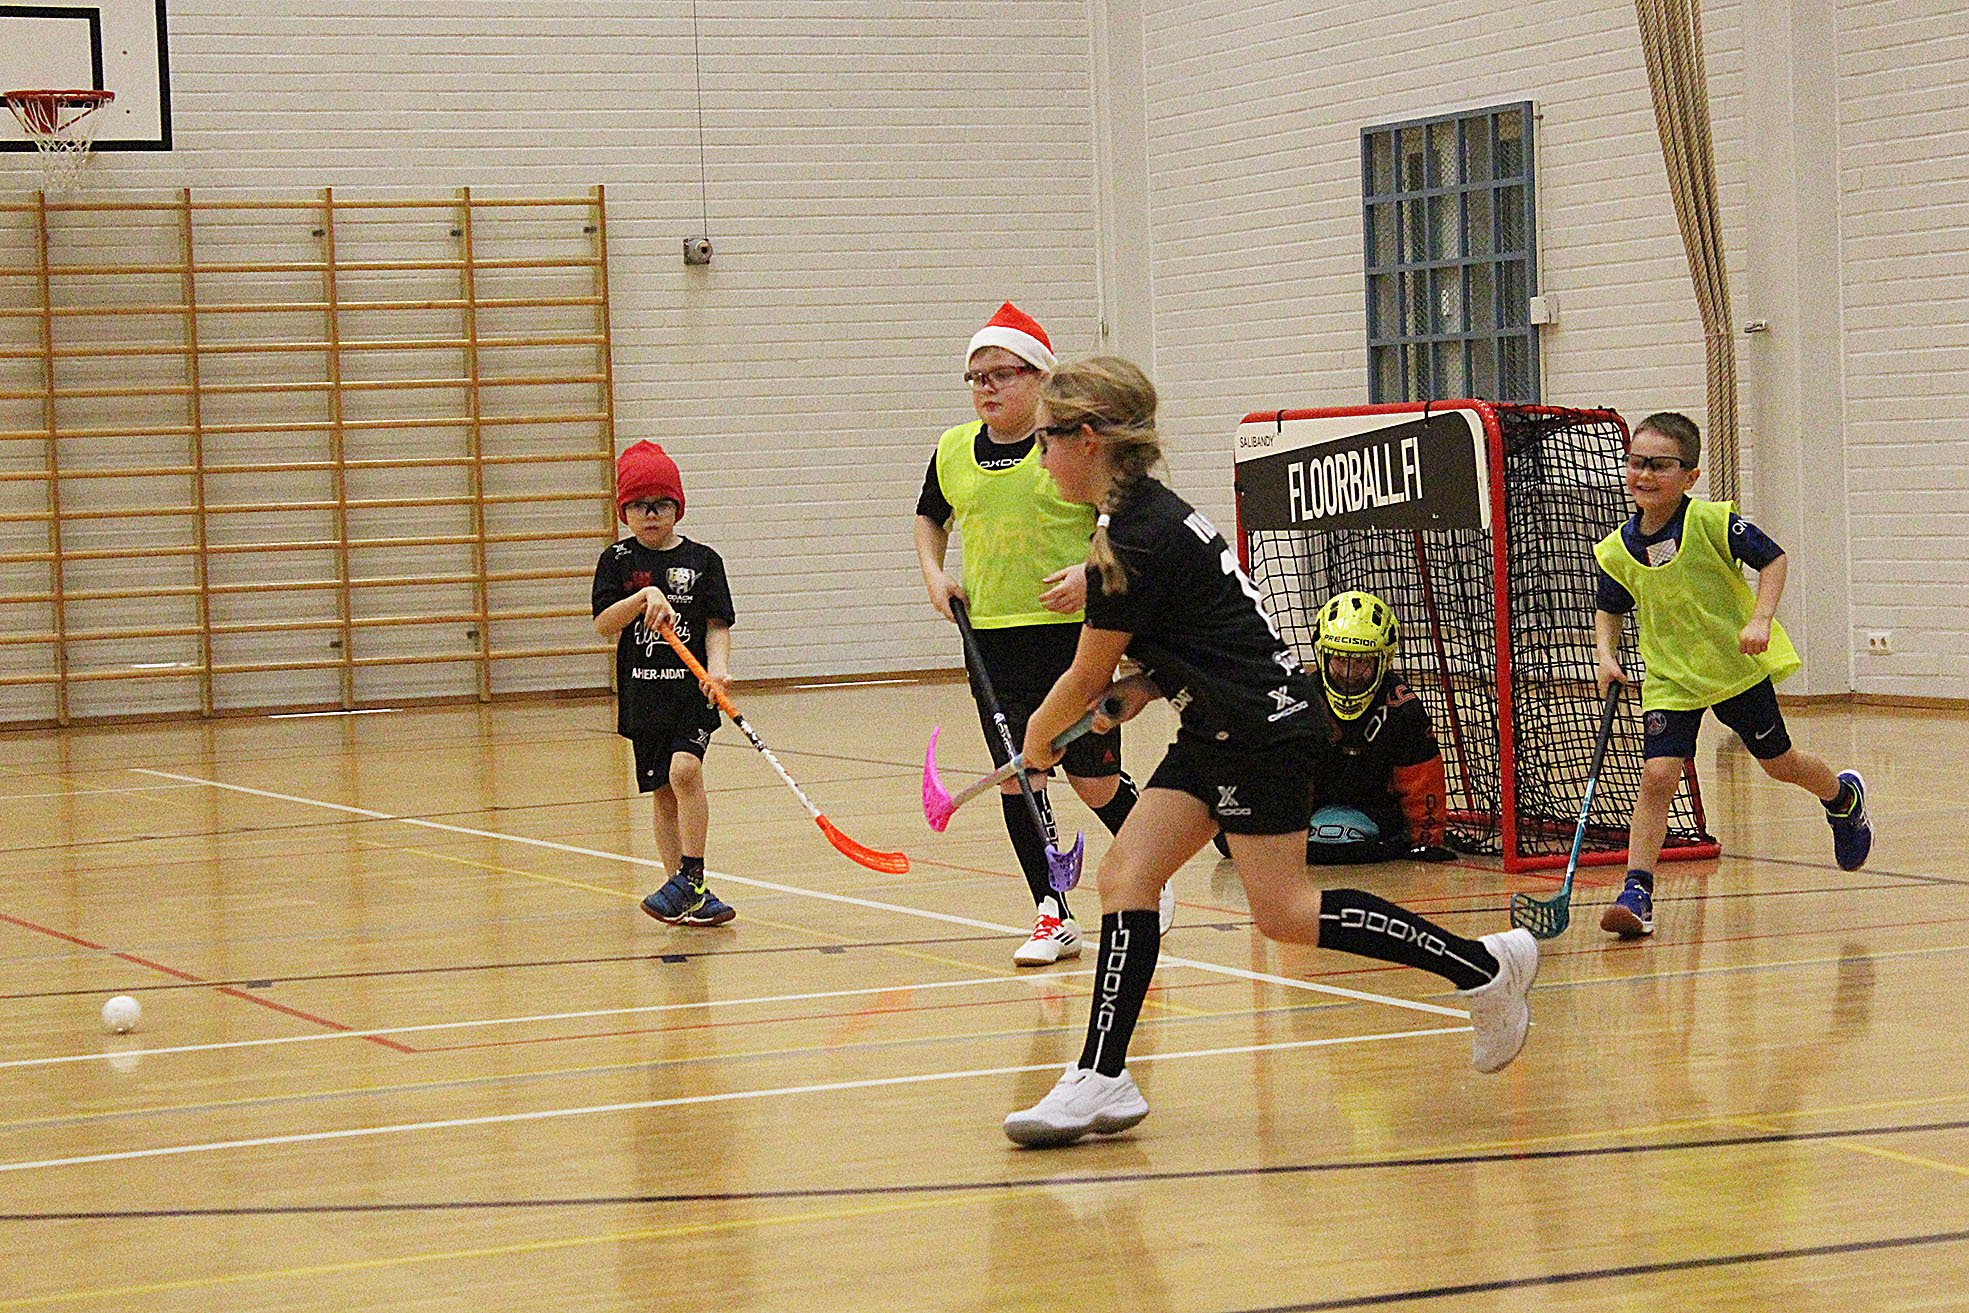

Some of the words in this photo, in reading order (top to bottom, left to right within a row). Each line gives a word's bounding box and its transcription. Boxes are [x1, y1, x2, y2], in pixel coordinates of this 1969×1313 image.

[1240, 434, 1275, 448] SALIBANDY
[980, 458, 1024, 468] OXDO
[1341, 907, 1446, 956] OXDOG
[1097, 929, 1130, 1032] OXDOG
